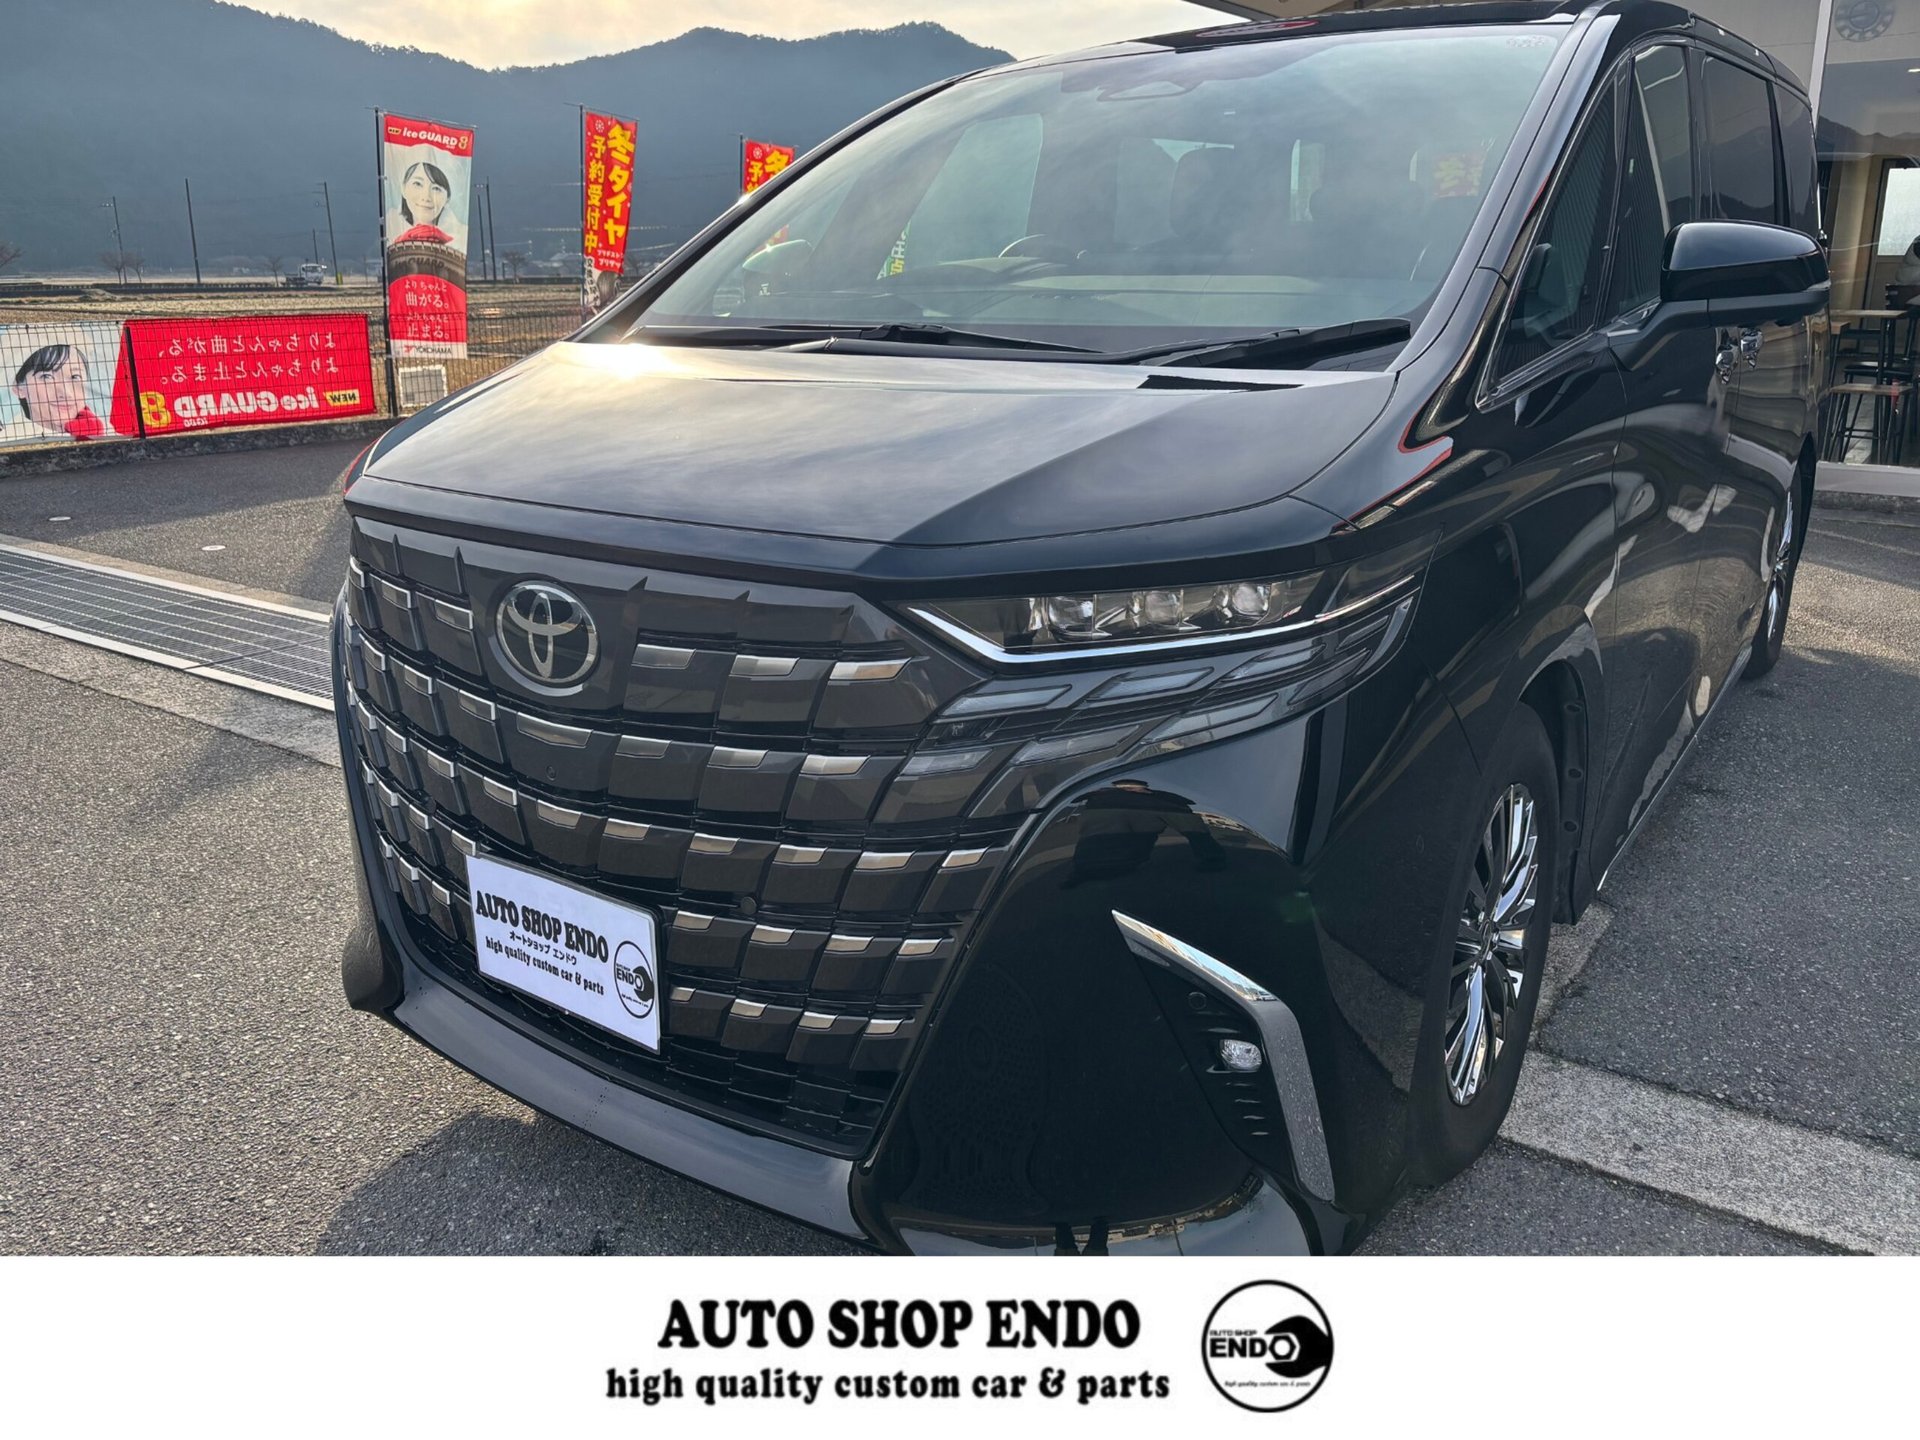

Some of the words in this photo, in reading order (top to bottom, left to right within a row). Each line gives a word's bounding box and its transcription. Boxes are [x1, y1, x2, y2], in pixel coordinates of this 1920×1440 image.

[458, 135, 469, 150] 8
[584, 134, 606, 254] 予約受付中
[604, 124, 635, 246] 冬タイヤ
[405, 291, 449, 309] 曲がる。
[476, 890, 519, 928] AUTO
[521, 905, 562, 944] SHOP
[563, 921, 609, 964] ENDO
[509, 930, 551, 954] オートショップ
[553, 948, 577, 966] エンドウ
[485, 936, 503, 954] high
[504, 945, 531, 967] quality
[532, 956, 559, 977] custom
[561, 969, 573, 983] car
[575, 971, 582, 986] &
[583, 978, 605, 996] parts
